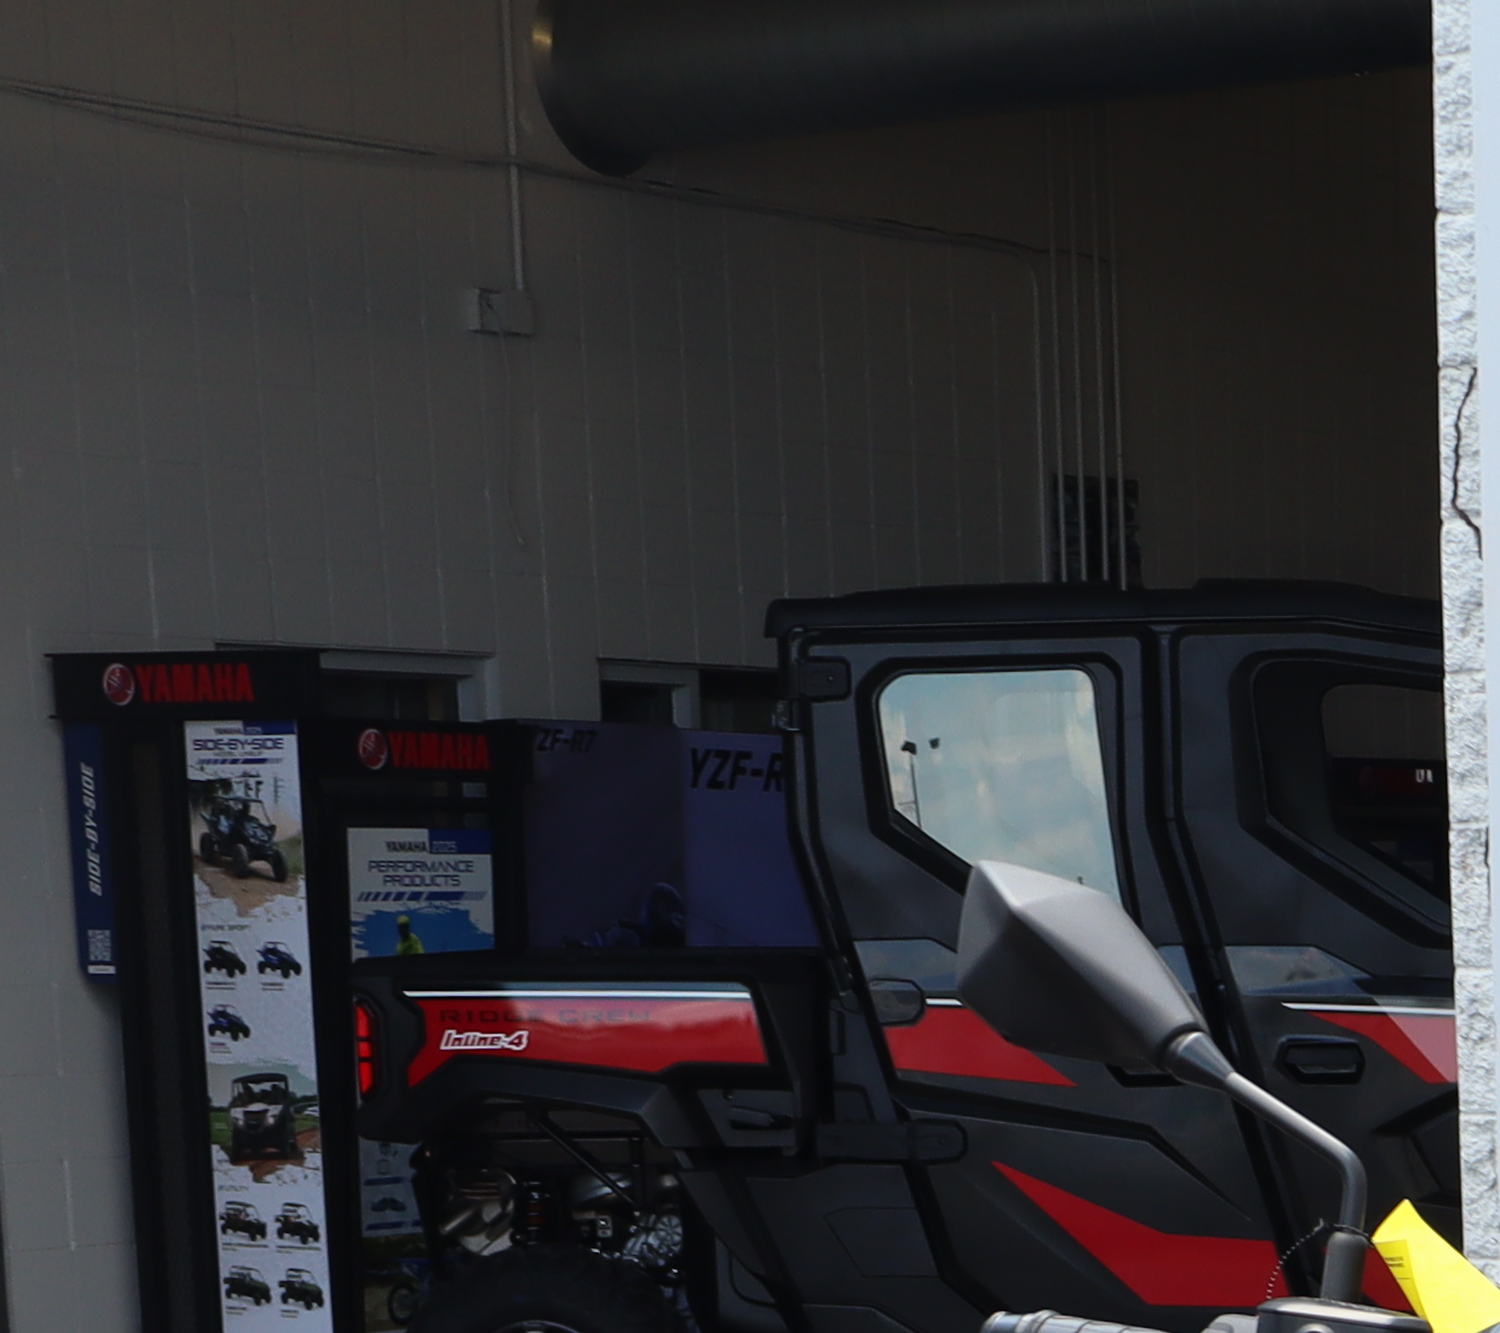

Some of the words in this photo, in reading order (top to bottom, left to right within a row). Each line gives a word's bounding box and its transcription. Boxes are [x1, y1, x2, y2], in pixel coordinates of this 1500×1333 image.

[135, 662, 255, 702] YAMAHA
[194, 738, 284, 750] SIDE-BY-SIDE
[533, 725, 596, 753] ZF-R7
[387, 732, 490, 771] YAMAHA
[80, 762, 103, 896] SIDE-BY-SIDE
[386, 841, 427, 852] YAMAHA
[368, 860, 474, 872] PERFORMANCE
[383, 875, 461, 886] PRODUCTS
[440, 1009, 545, 1023] RIDGE
